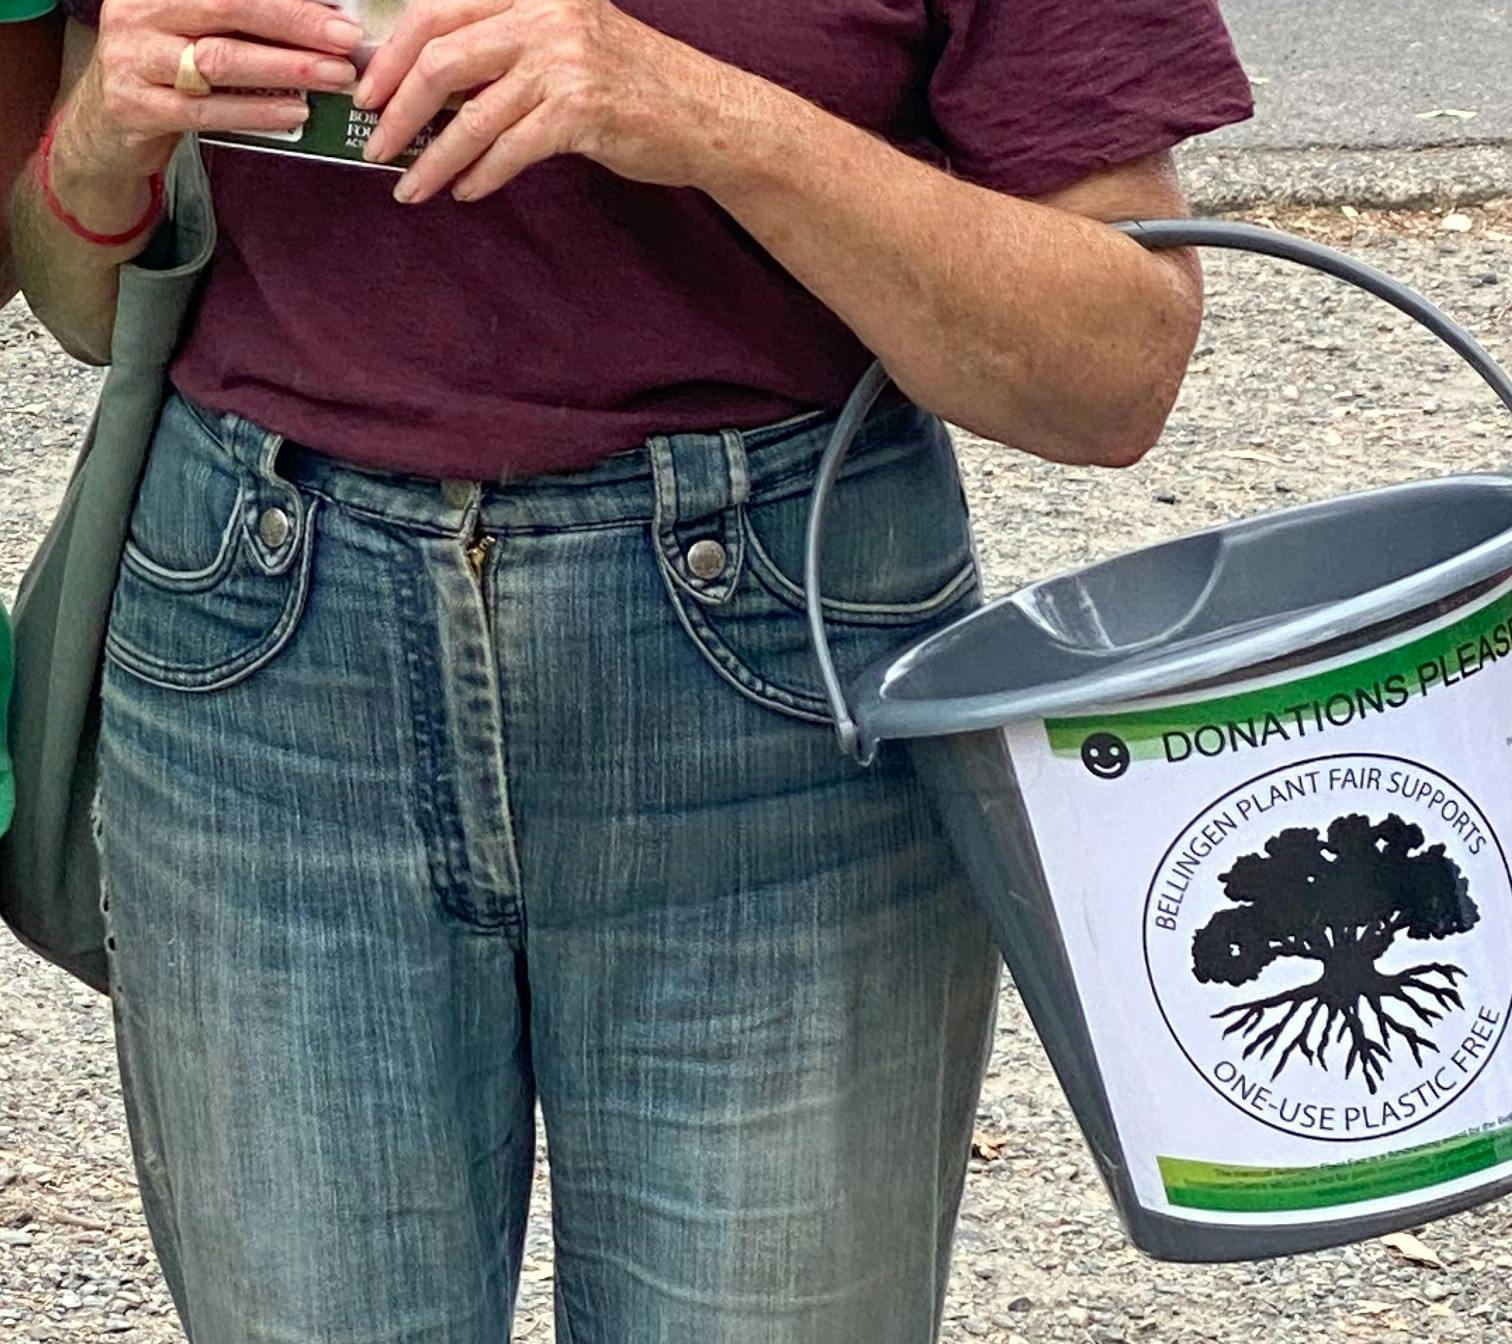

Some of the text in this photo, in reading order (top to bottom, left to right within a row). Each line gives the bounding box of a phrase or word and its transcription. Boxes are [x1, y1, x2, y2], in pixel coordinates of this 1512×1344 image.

[1163, 616, 1512, 763] DONATIONS PLEAS
[1155, 767, 1487, 931] BELLINGEN PLANT FAIR SUPPORTS
[1214, 1006, 1500, 1131] ONE-USE PLASTIC FREE
